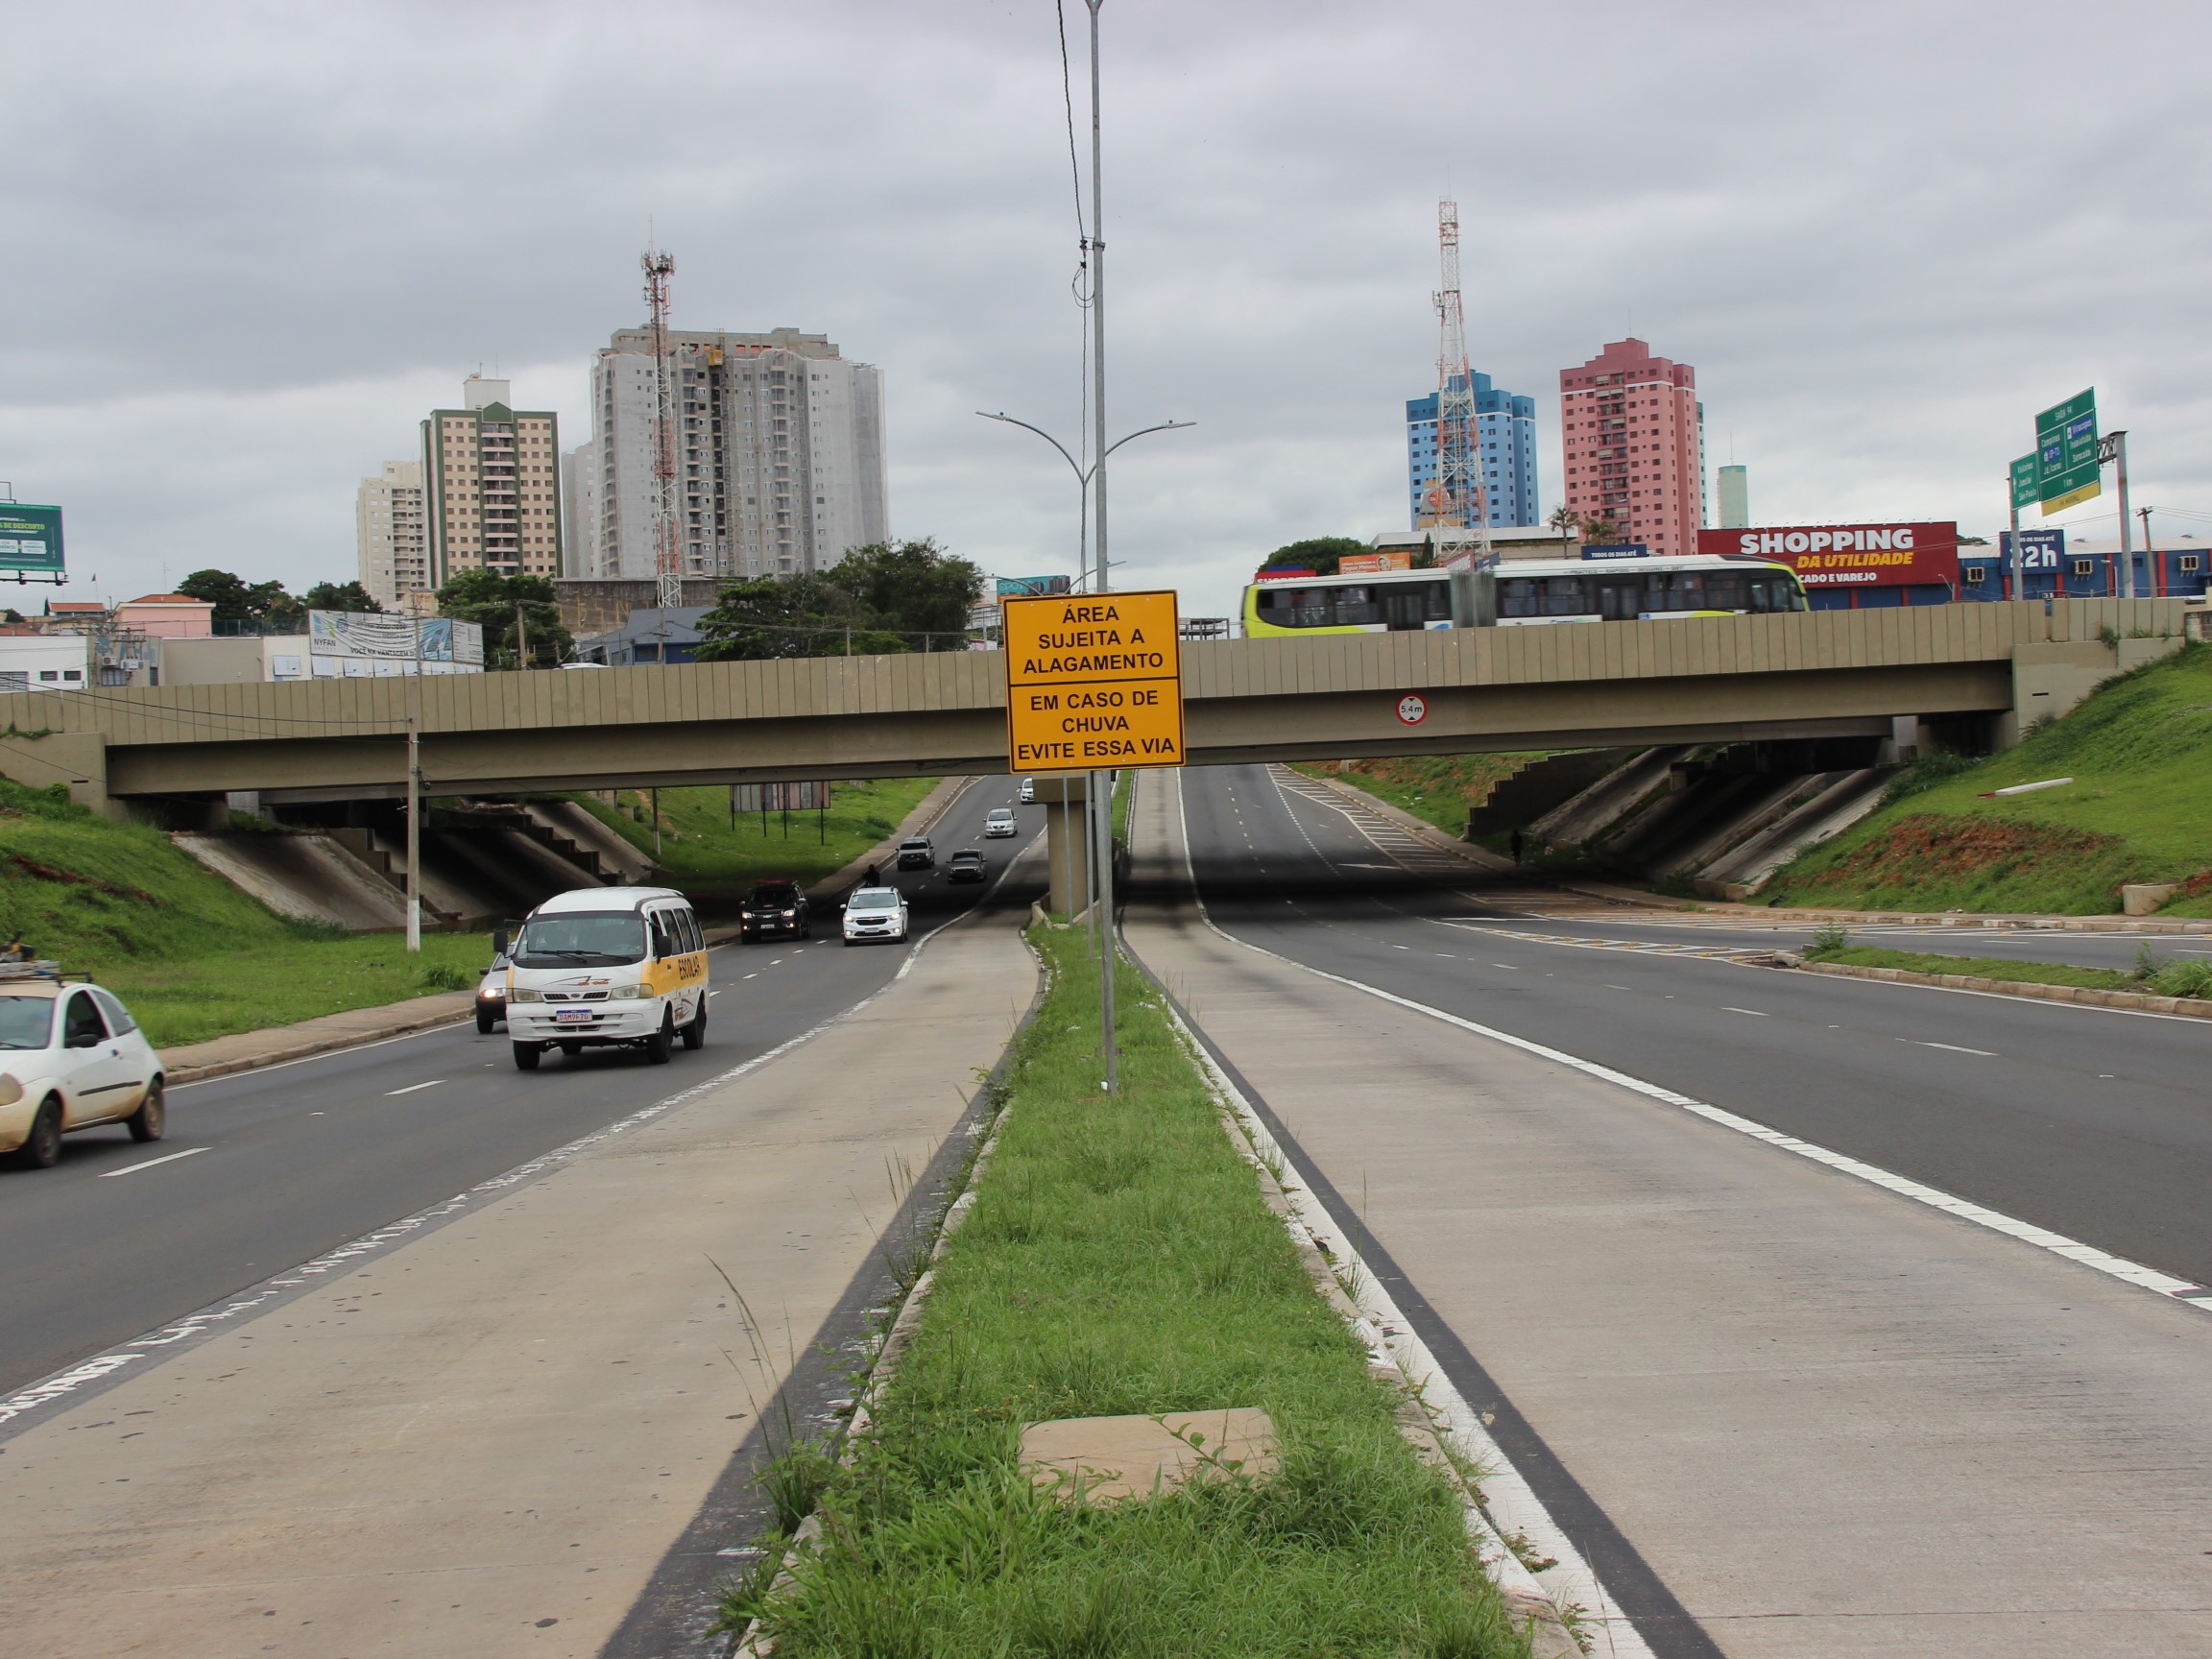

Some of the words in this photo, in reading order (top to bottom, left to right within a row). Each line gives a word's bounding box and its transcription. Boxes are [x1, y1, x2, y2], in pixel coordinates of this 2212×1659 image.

[1740, 528, 1914, 555] SHOPPING
[1796, 555, 1821, 568] DA
[1824, 551, 1914, 567] UTILIDADE
[1828, 573, 1835, 583] E
[1836, 572, 1877, 583] VAREJO
[1062, 604, 1119, 624] ÁREA
[1038, 630, 1121, 650] SUJEITA
[1130, 629, 1145, 644] A
[1022, 652, 1164, 674] ALAGAMENTO
[1030, 695, 1059, 711] EM
[1067, 691, 1124, 709] CASO
[1132, 690, 1159, 706] DE
[1062, 715, 1130, 733] CHUVA
[1018, 742, 1075, 759] EVITE
[1084, 739, 1136, 757] ESSA
[1141, 737, 1175, 754] VIA
[678, 955, 702, 980] ESCOLAR
